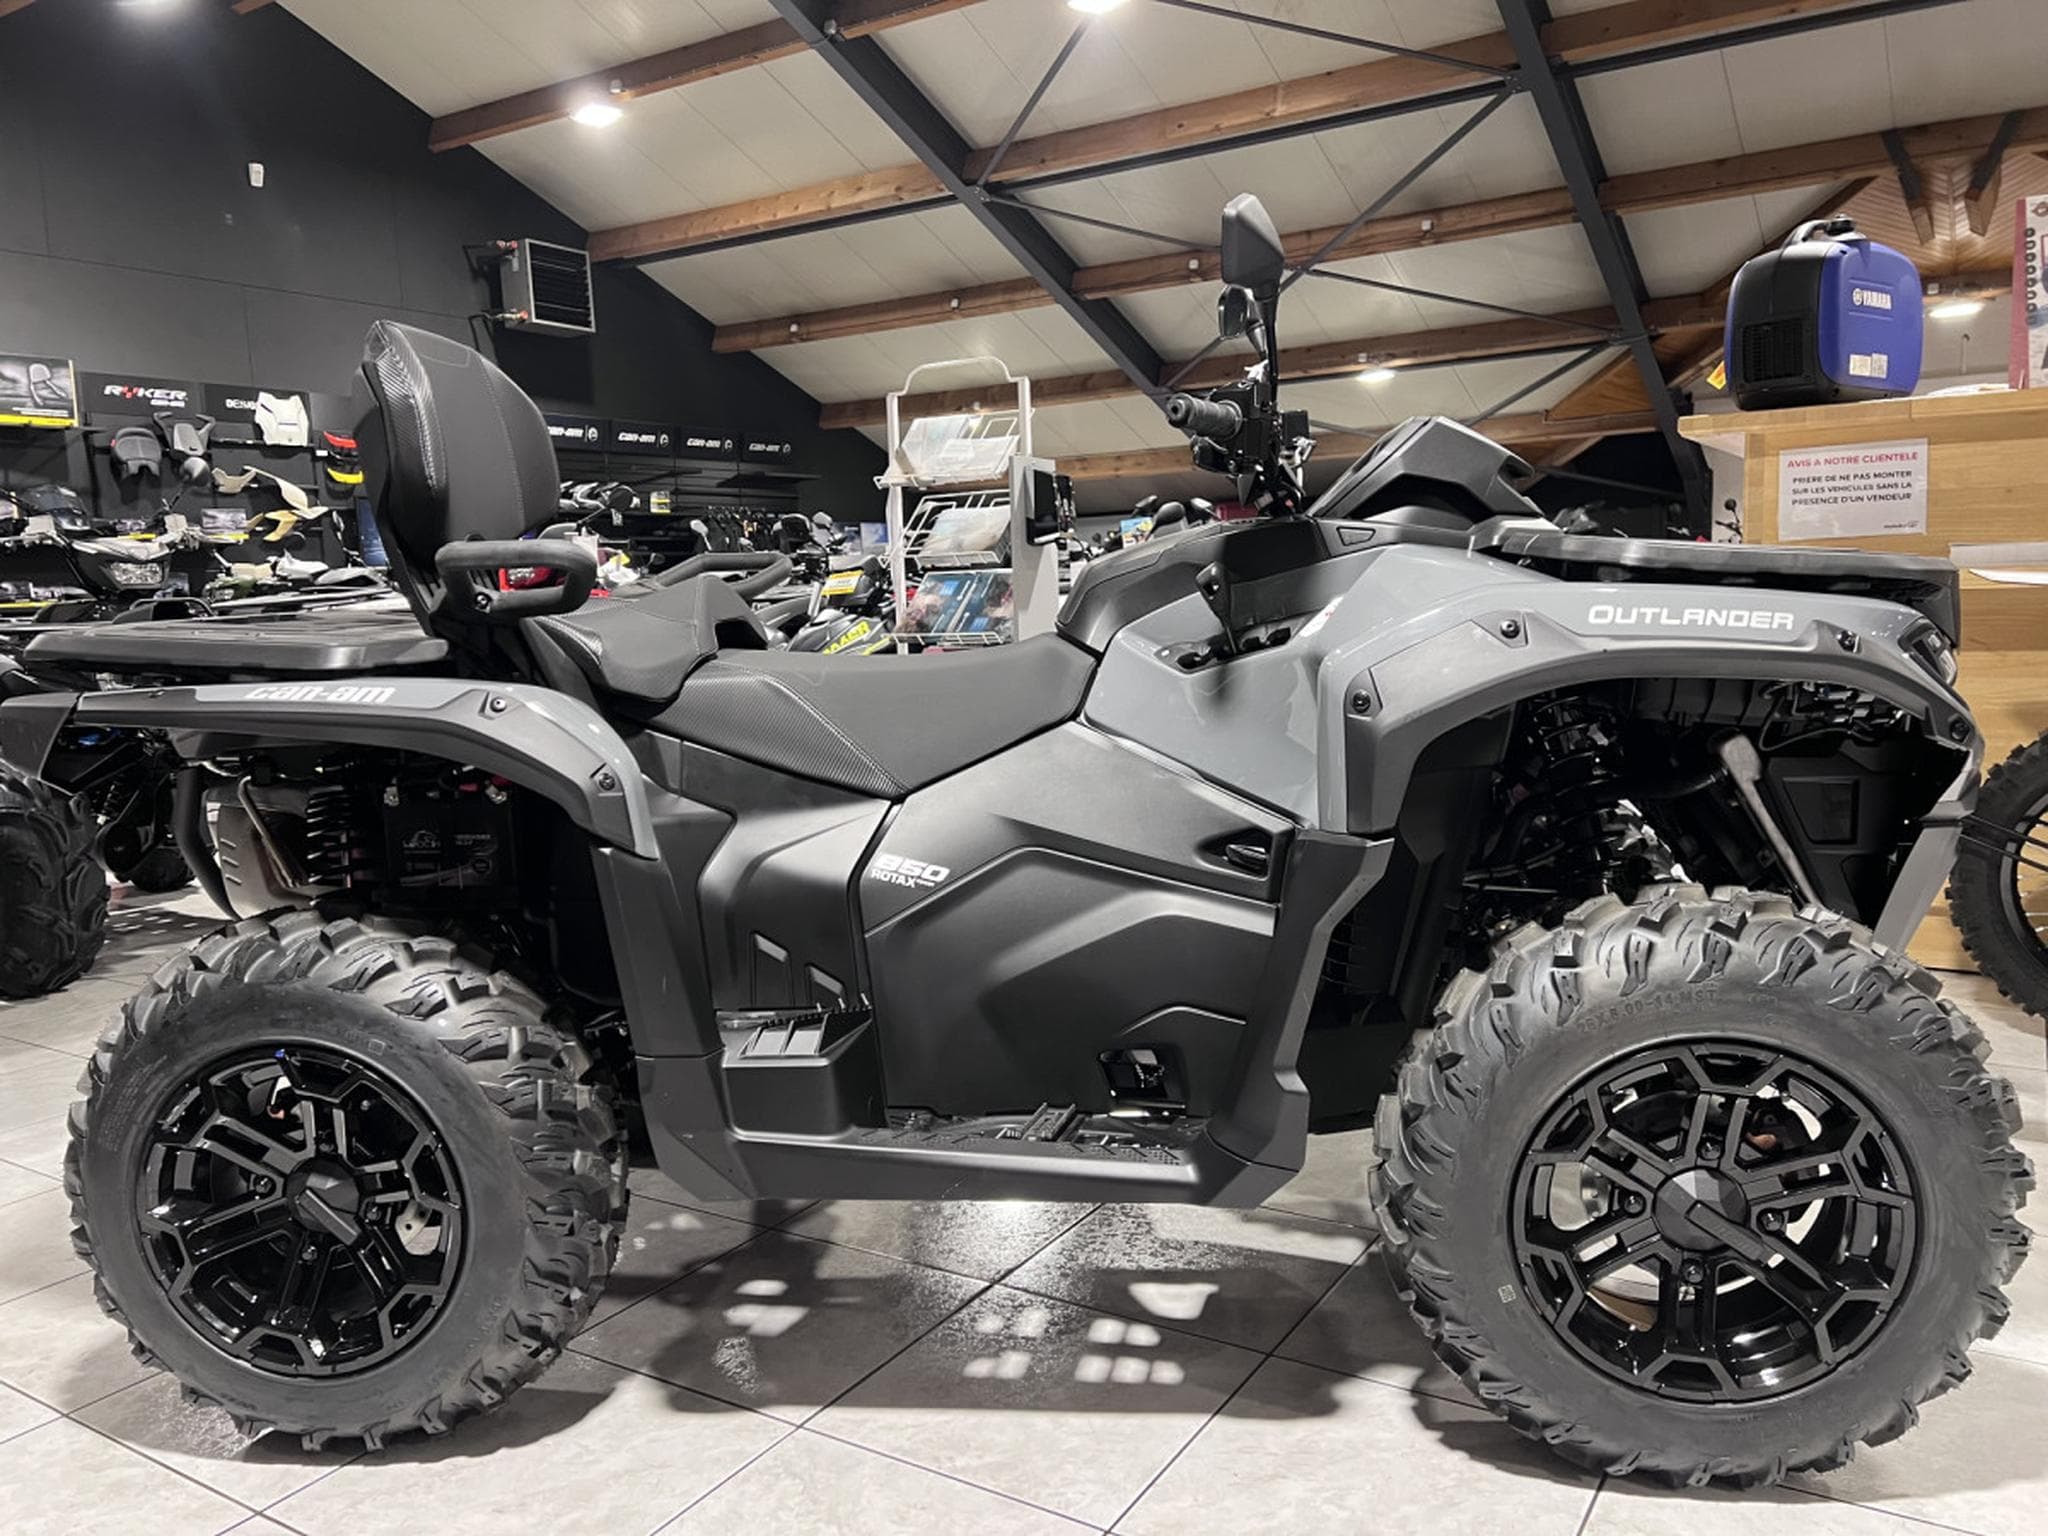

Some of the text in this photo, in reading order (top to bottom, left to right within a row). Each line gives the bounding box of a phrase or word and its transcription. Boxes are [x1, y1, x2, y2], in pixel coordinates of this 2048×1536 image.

[1788, 458, 1811, 468] AVIS
[1824, 456, 1859, 465] NOTRE
[1853, 472, 1871, 480] PAS
[1873, 470, 1912, 479] MONTER
[1792, 487, 1809, 495] SUR
[1811, 486, 1825, 494] LES
[1876, 482, 1899, 490] SANS
[1901, 481, 1912, 489] LA
[1867, 493, 1912, 502] VENDEUR
[1587, 604, 1795, 631] OUTLANDER
[245, 686, 397, 704] can-am
[874, 854, 950, 882] 850
[871, 868, 915, 888] ROTAX
